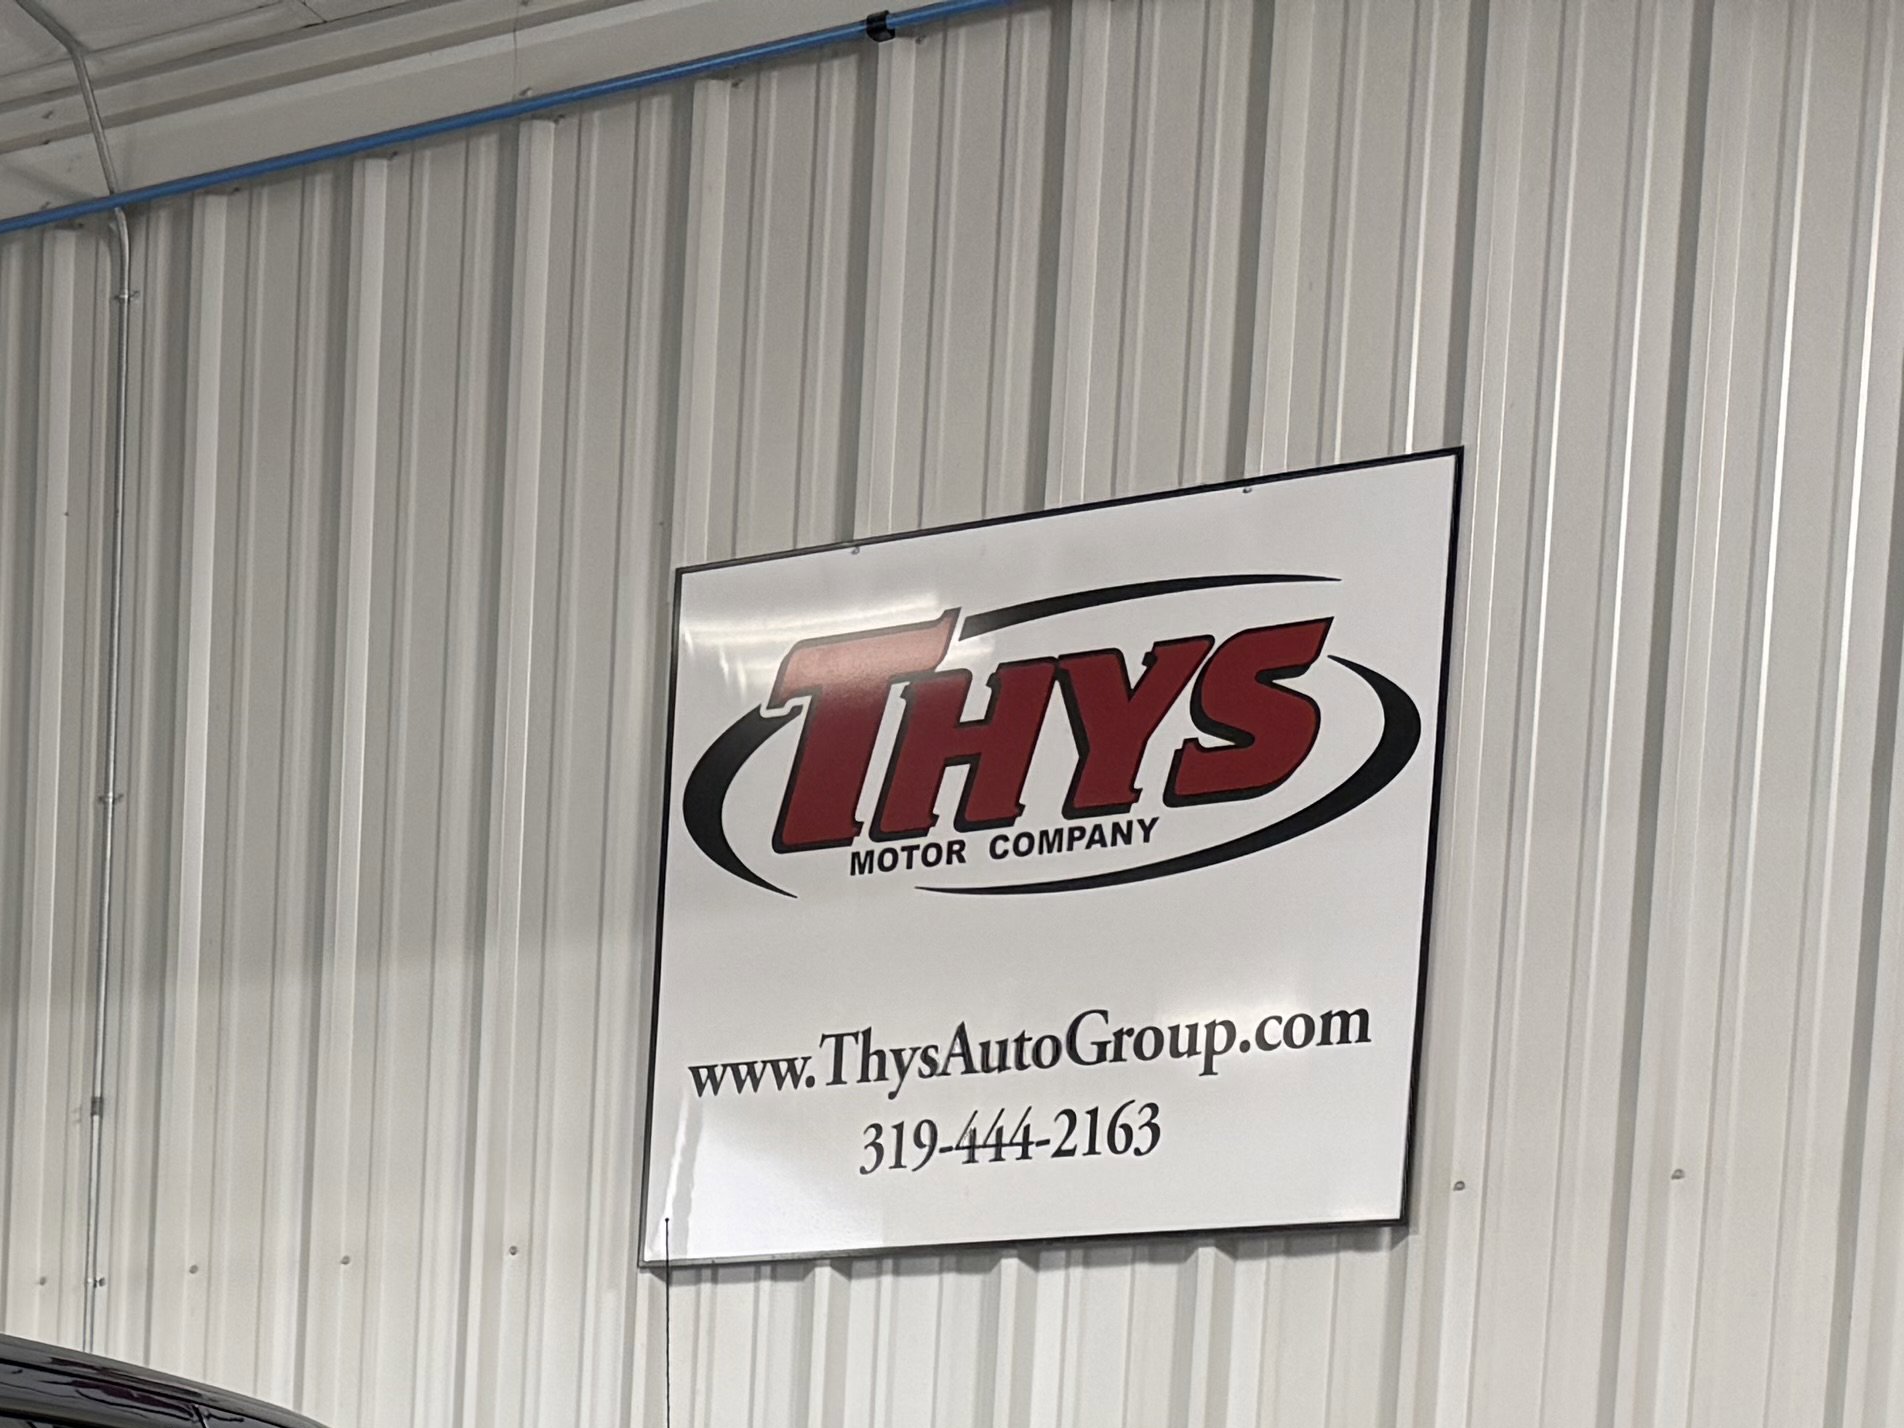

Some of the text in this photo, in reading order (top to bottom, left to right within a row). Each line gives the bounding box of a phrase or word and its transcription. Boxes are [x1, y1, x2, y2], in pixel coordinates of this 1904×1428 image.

[769, 607, 1334, 855] THYS
[849, 816, 1160, 877] MOTOR COMPANY
[688, 1003, 1372, 1100] www.ThysAutoGroup.com
[858, 1099, 1162, 1176] 319-444-2163
